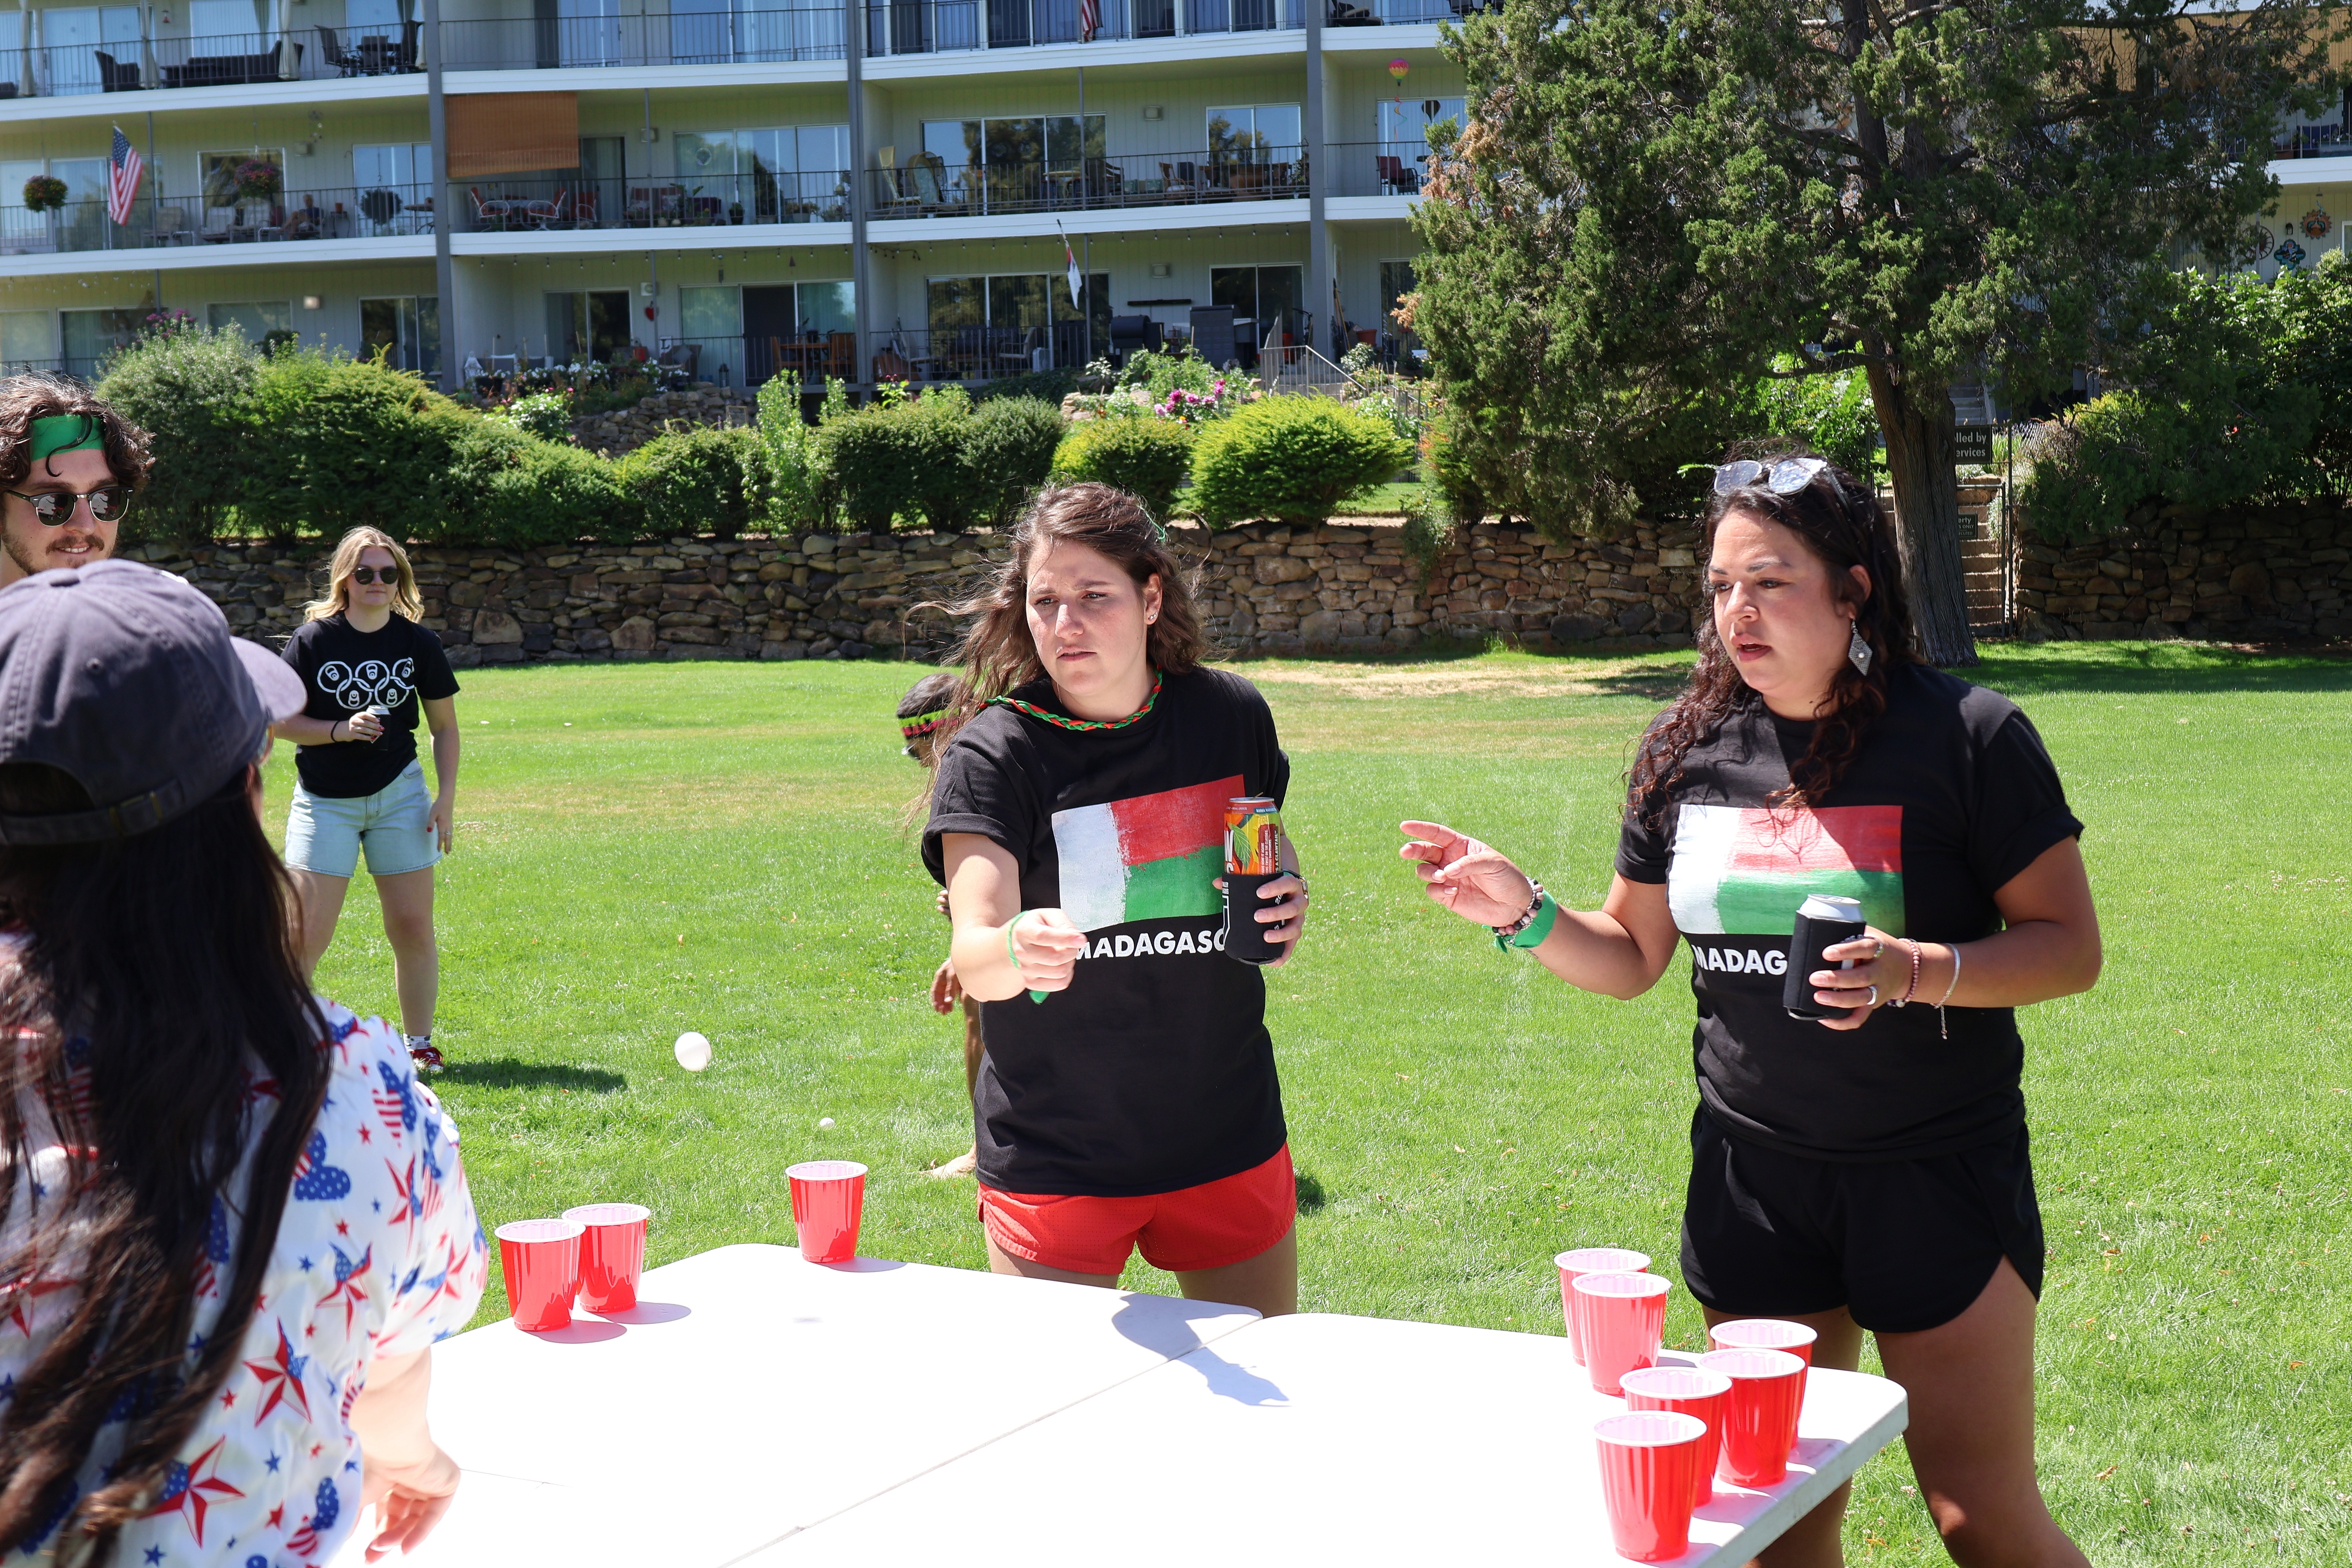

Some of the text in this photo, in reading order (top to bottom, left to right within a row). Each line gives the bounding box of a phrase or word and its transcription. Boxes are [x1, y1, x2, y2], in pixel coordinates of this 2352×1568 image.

[1955, 432, 1987, 445] lled by
[1275, 894, 1283, 905] 20
[1691, 944, 1788, 975] MADAG
